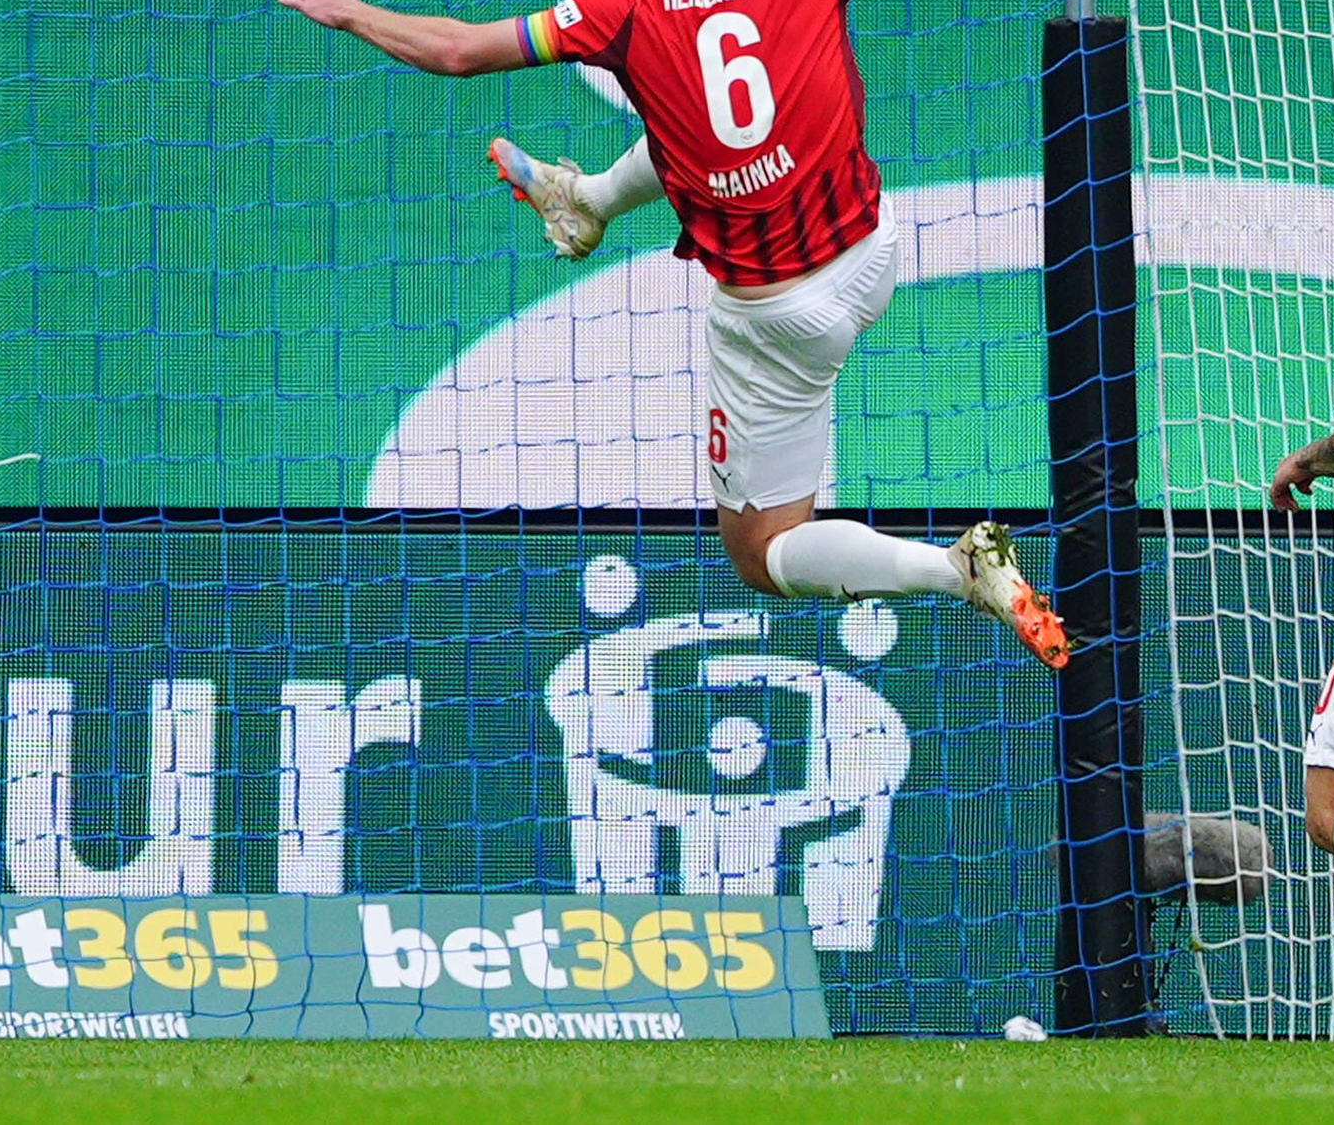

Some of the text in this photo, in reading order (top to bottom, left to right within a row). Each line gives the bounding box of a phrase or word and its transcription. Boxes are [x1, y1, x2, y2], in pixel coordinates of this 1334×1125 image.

[697, 12, 776, 149] 6
[708, 144, 796, 199] MAINKA
[708, 408, 727, 464] 6
[357, 903, 776, 992] bet365
[488, 1011, 684, 1041] SPORTWETTEN
